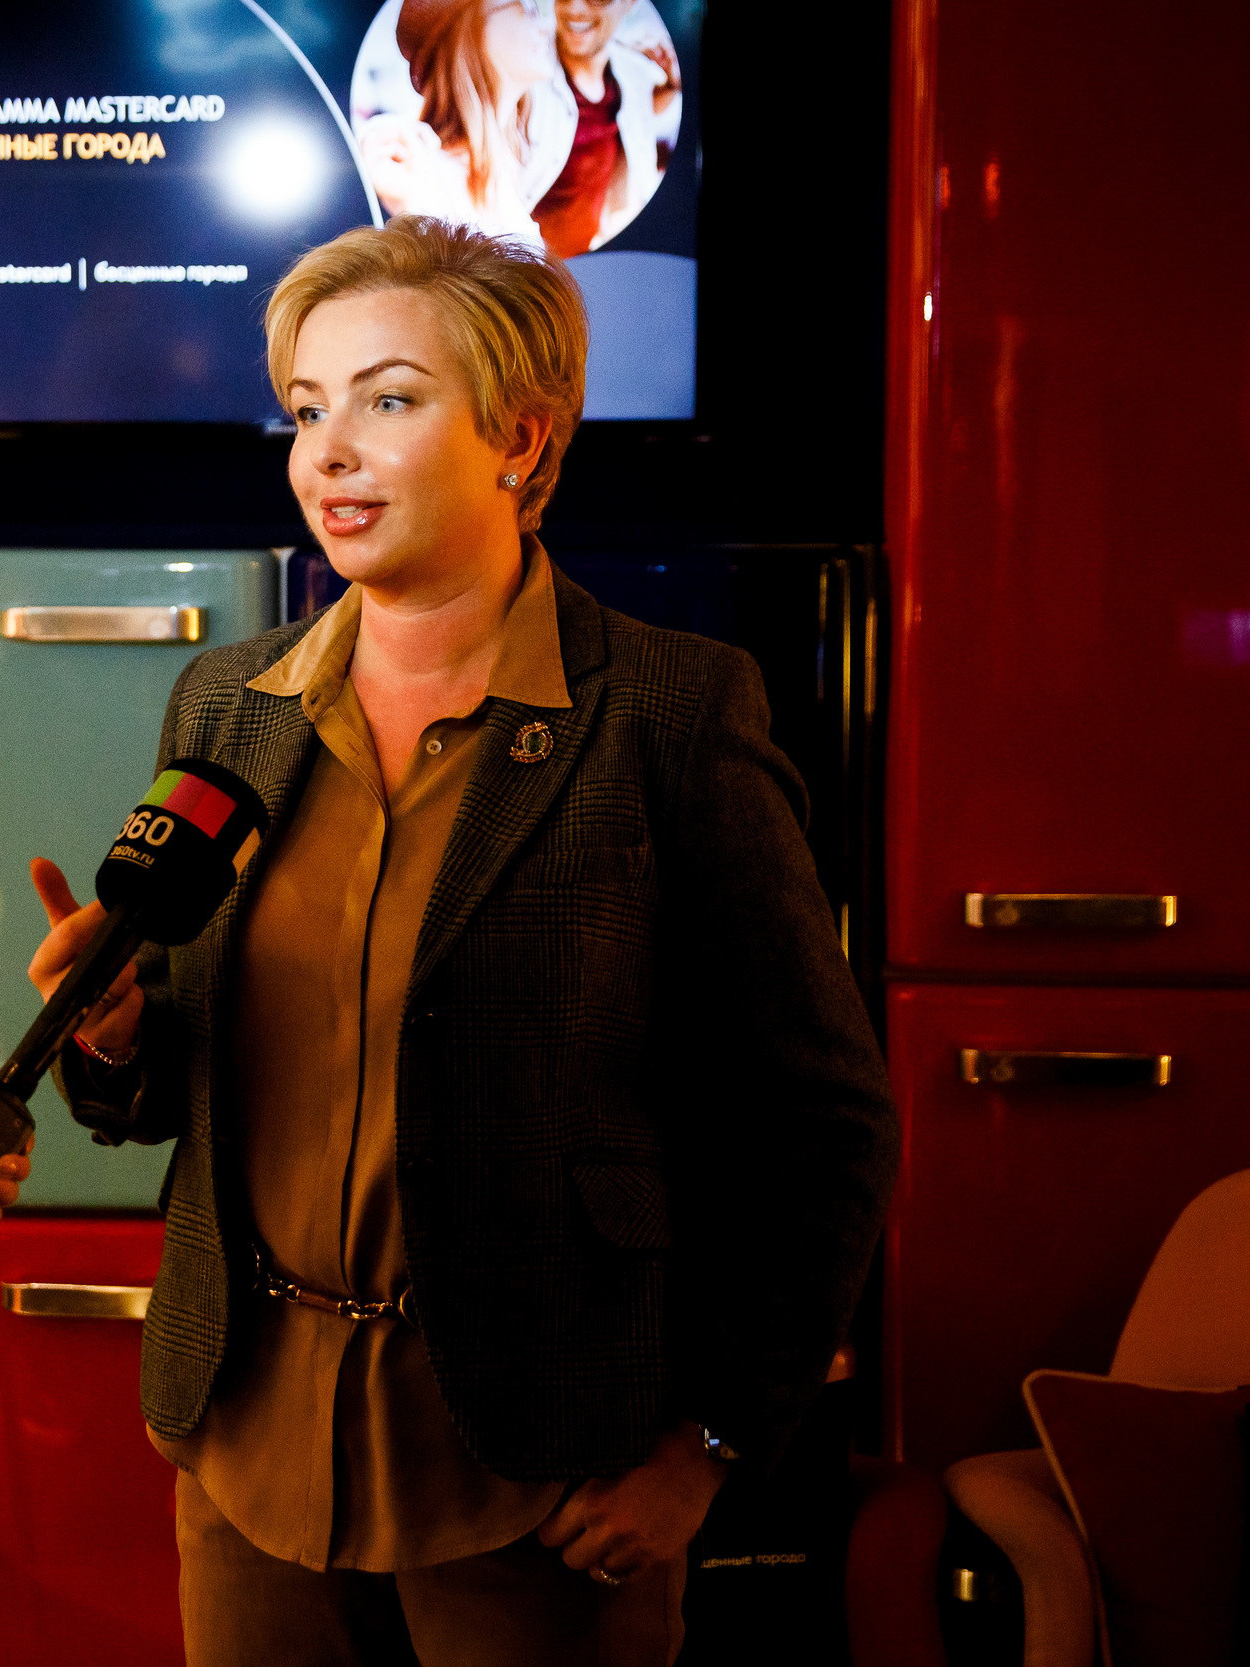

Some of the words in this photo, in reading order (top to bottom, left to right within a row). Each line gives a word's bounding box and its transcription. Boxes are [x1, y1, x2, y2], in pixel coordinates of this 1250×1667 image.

[64, 95, 225, 123] MASTERCARD
[63, 132, 166, 164] ГОРОДА
[700, 1555, 753, 1569] ценные
